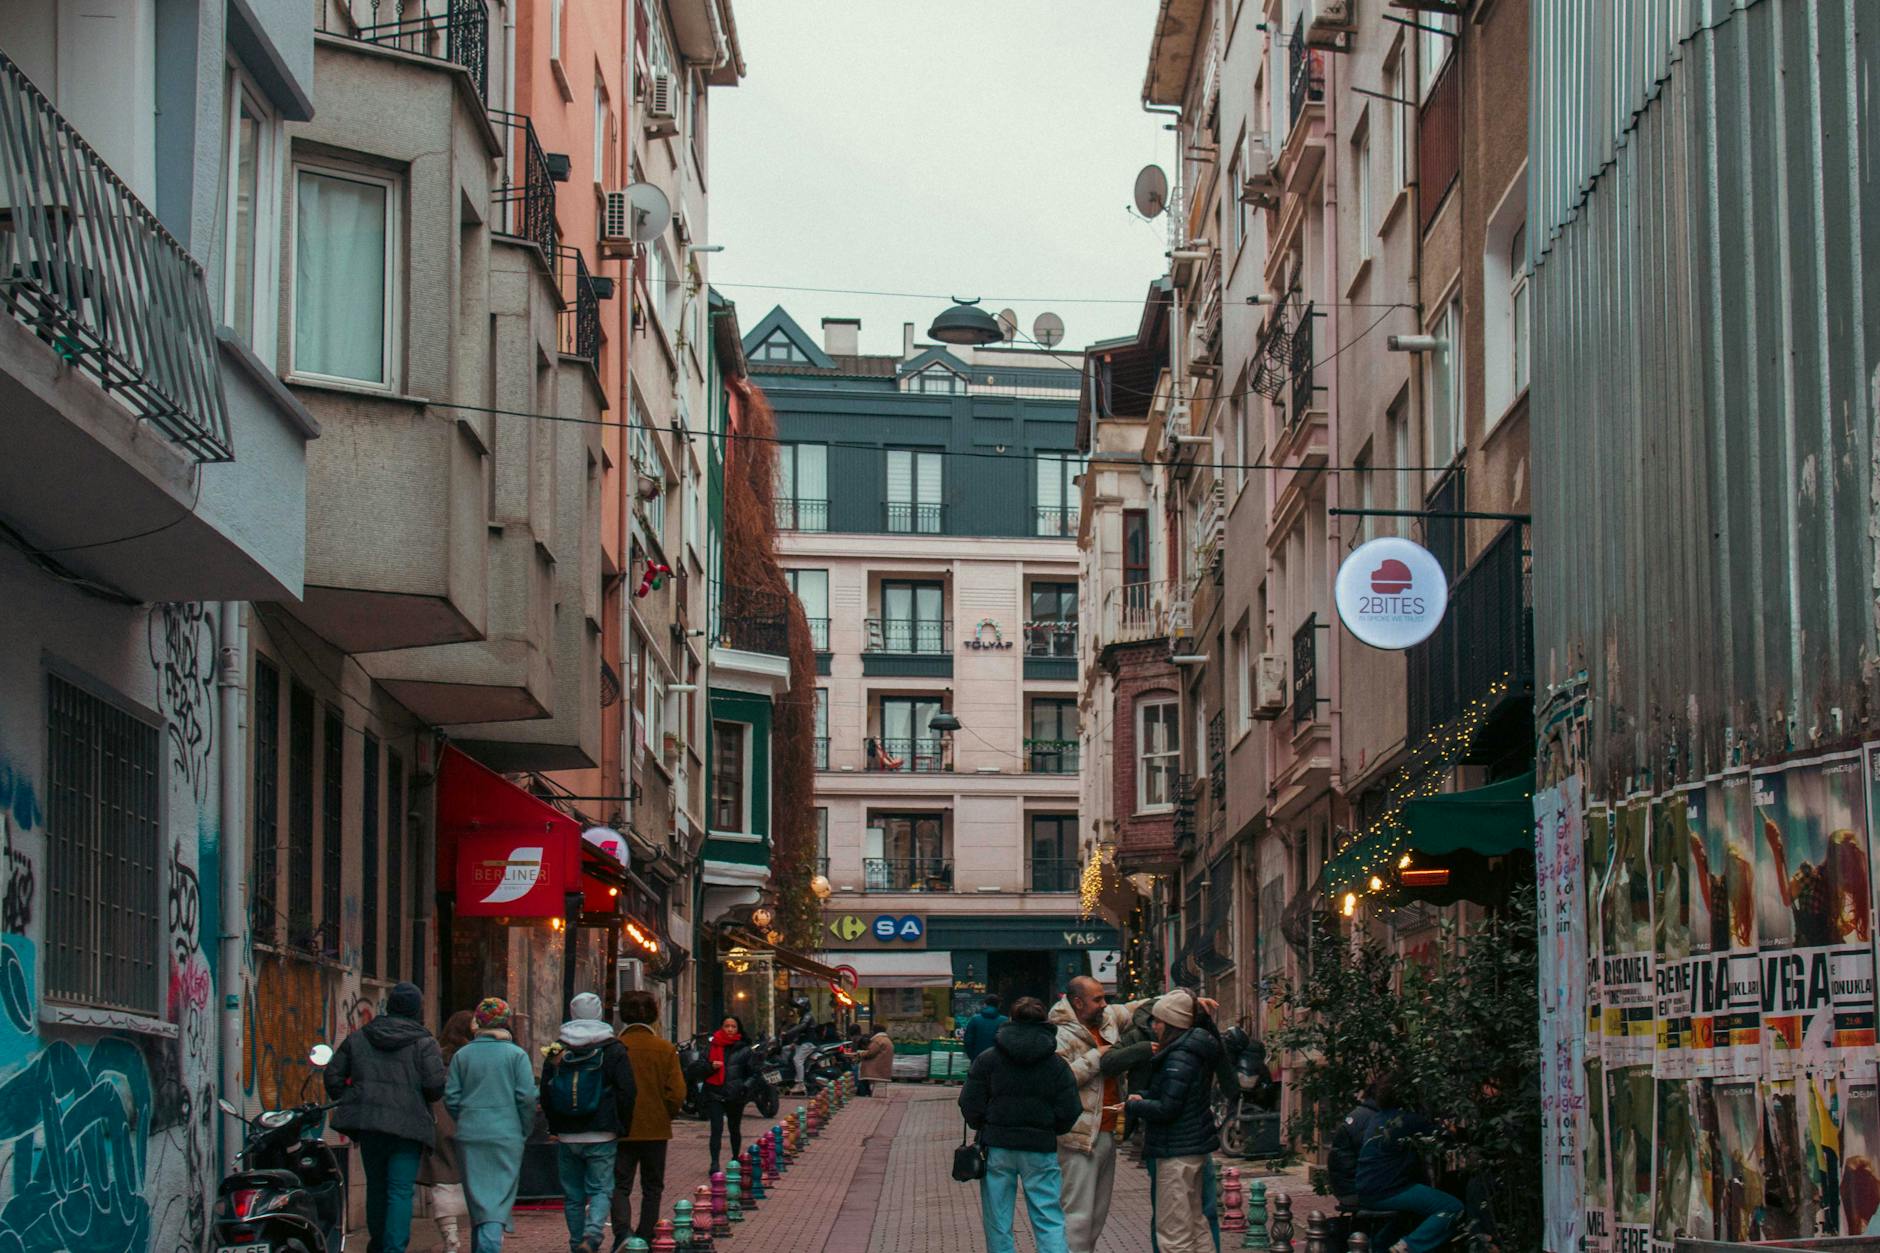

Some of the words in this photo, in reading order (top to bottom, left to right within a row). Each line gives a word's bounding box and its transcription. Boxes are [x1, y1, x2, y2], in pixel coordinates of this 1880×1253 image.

[1359, 596, 1425, 615] 2BITES
[475, 869, 547, 881] BERLINER
[876, 920, 921, 935] SA
